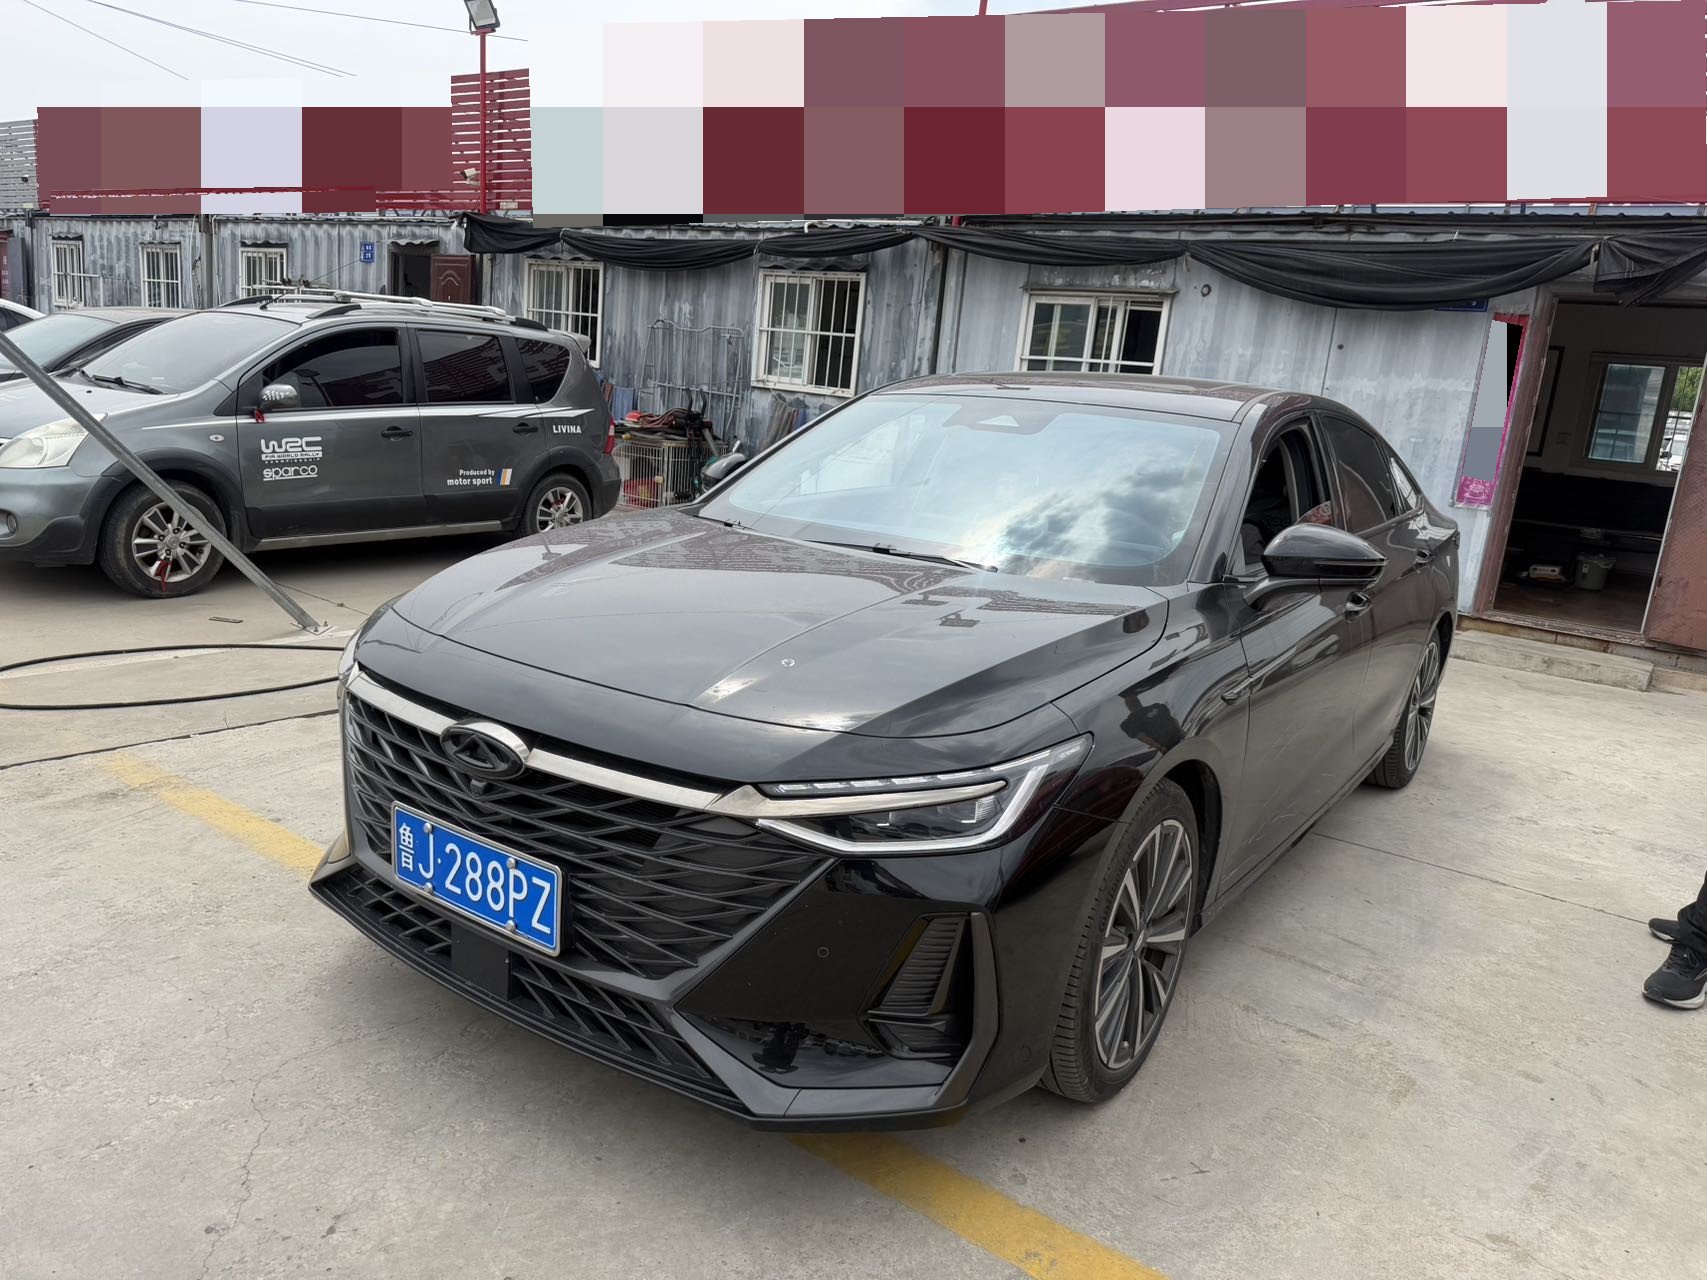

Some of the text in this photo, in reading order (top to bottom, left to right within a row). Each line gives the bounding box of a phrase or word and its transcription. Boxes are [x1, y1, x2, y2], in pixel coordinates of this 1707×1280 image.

[552, 424, 582, 434] LIVINA
[260, 436, 322, 453] WRC
[263, 465, 318, 480] sparco
[446, 477, 493, 486] motor sport
